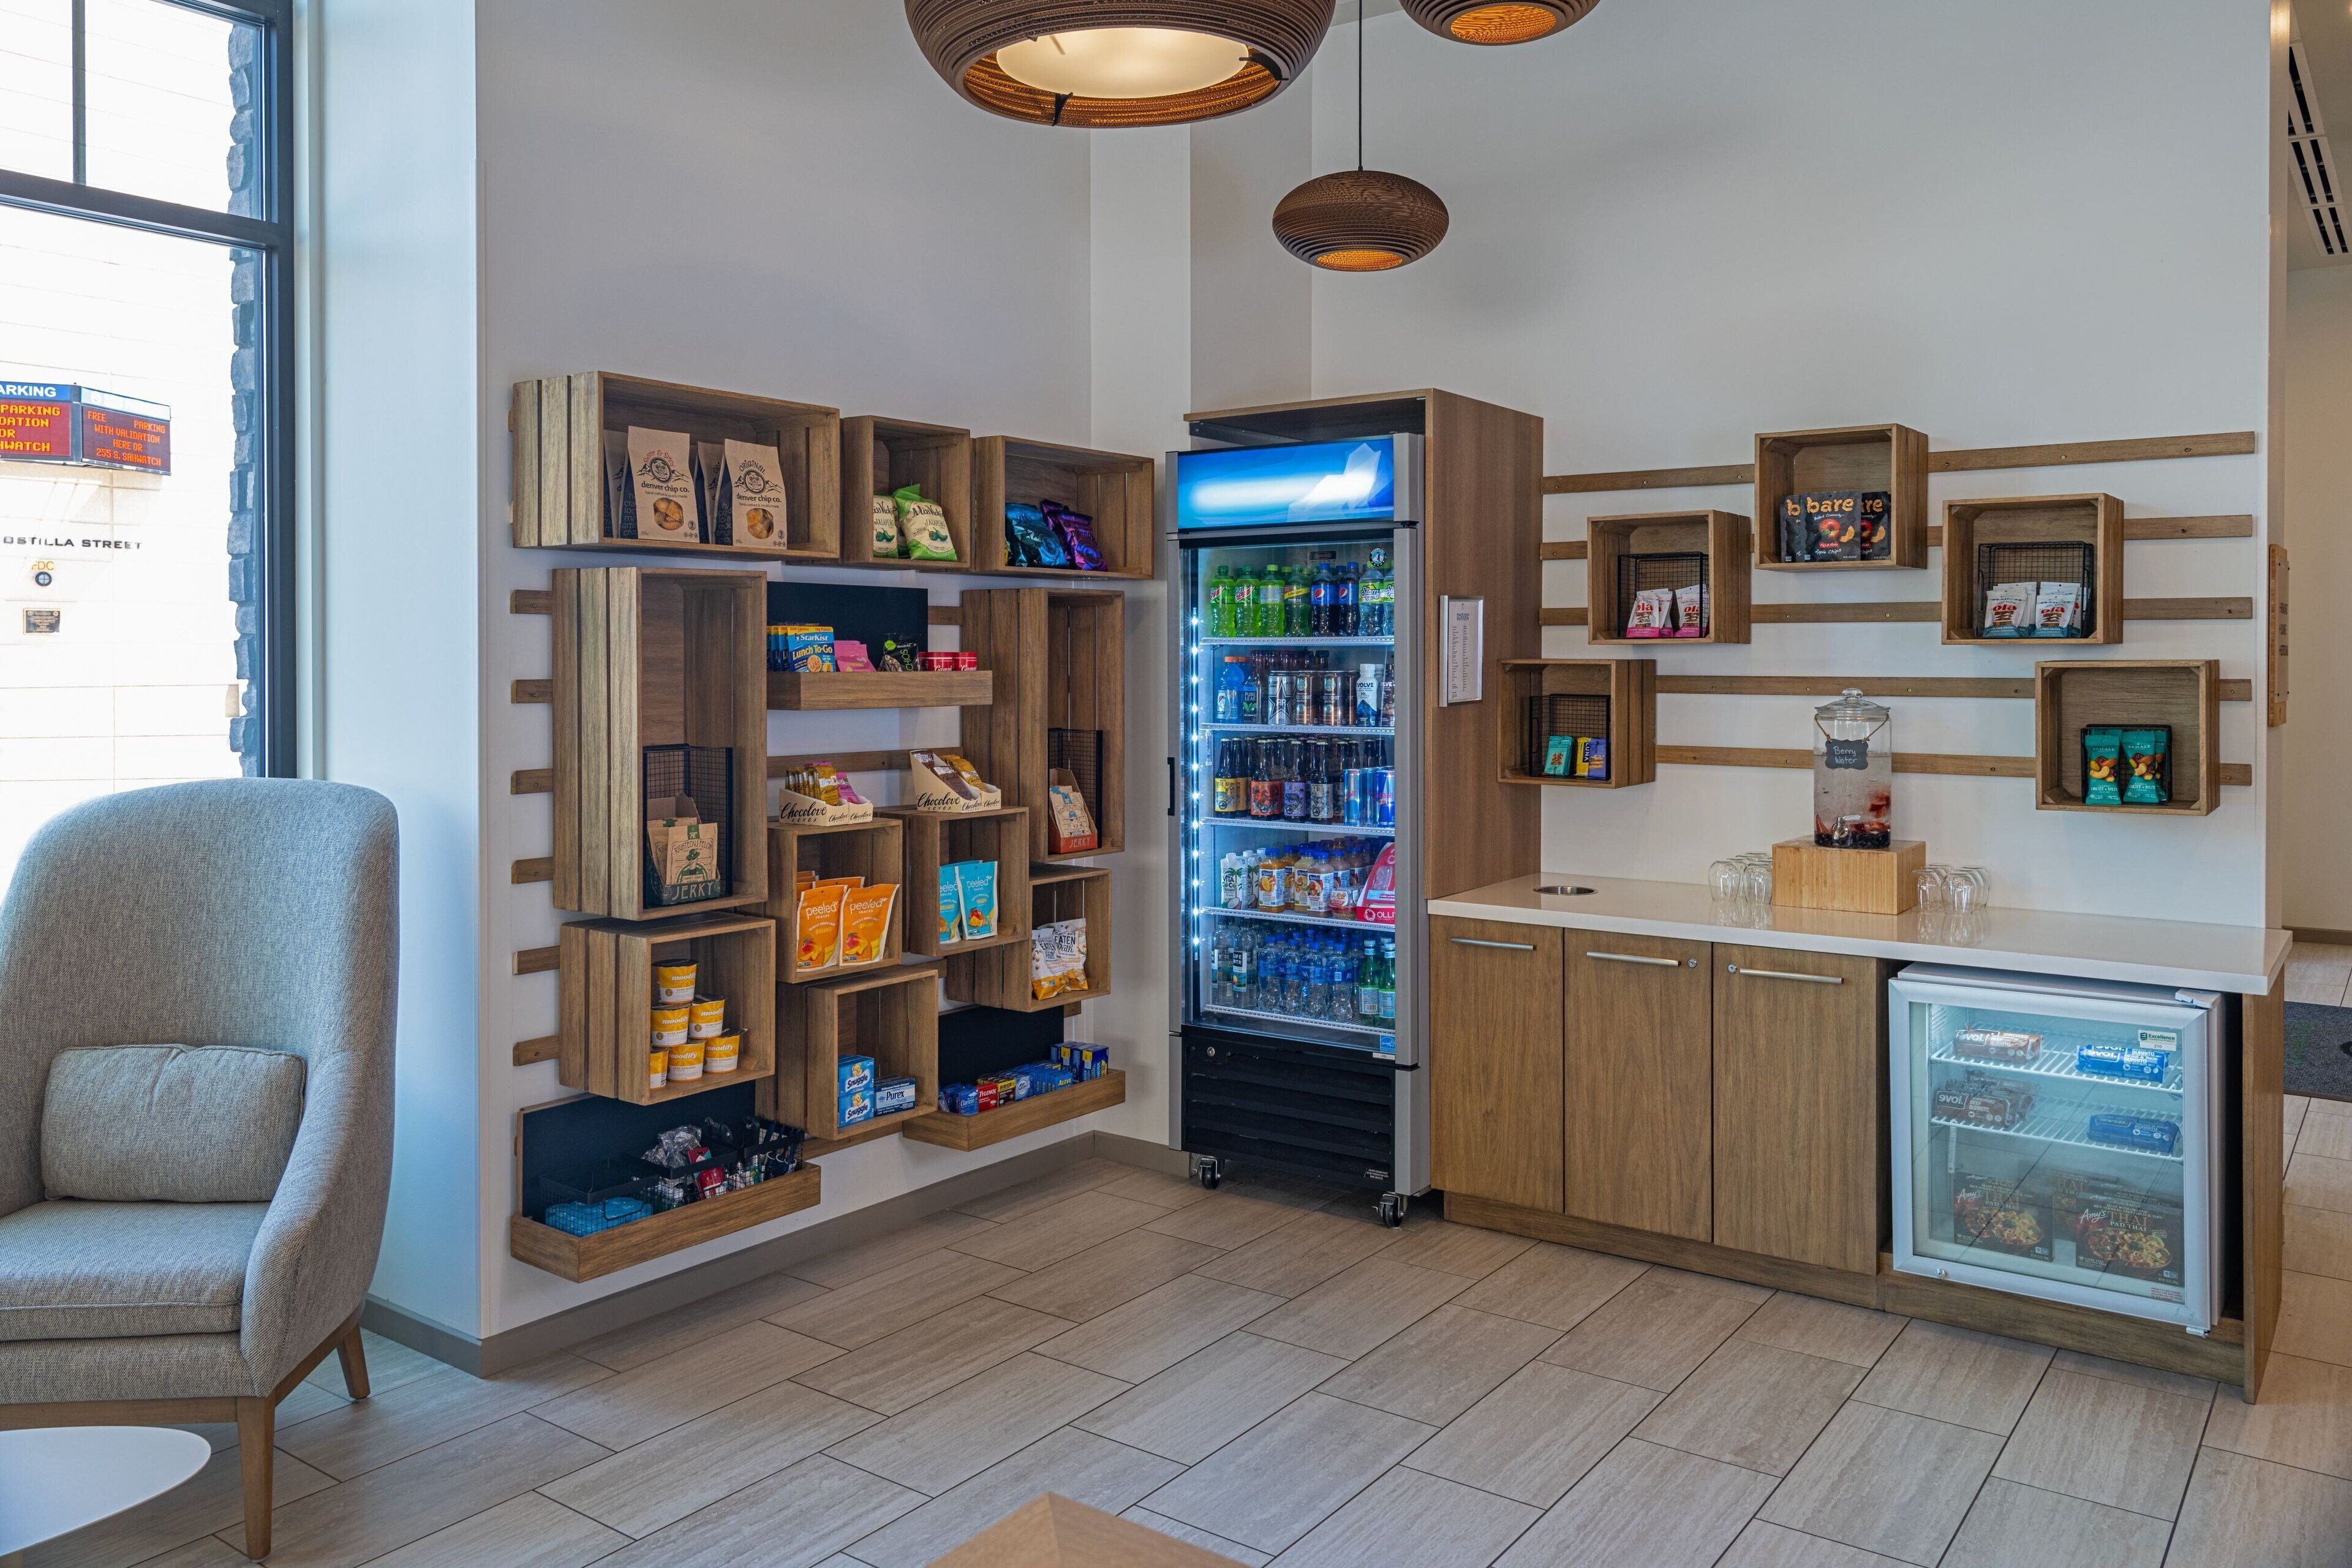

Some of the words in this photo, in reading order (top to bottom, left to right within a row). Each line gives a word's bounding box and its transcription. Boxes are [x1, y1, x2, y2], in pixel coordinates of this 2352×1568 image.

[1, 404, 61, 416] PARKING
[88, 410, 107, 422] FREE
[134, 420, 165, 434] PARKING
[94, 424, 114, 435] WITH
[116, 428, 160, 443] VALIDATION
[113, 439, 131, 450] HERE
[133, 443, 143, 451] OR
[96, 448, 111, 458] 255
[113, 451, 120, 459] S.
[123, 452, 162, 466] SAHWATCH
[641, 481, 663, 491] denver
[736, 493, 757, 502] denver
[1806, 497, 1854, 513] bare
[82, 540, 142, 549] STREET
[1361, 585, 1381, 598] Starry
[1636, 603, 1653, 611] ola
[793, 646, 813, 661] Lunch
[1833, 745, 1856, 756] Berry
[1834, 756, 1857, 764] Water
[916, 792, 960, 807] Chocolove
[983, 798, 1001, 808] Chocolove
[780, 801, 827, 819] Chocolove
[962, 800, 982, 812] Chocolove
[829, 813, 848, 822] Chocolove
[850, 812, 872, 820] Chocolove
[1069, 837, 1091, 848] JERKY
[967, 877, 989, 891] peeled
[672, 881, 714, 900] JERKY
[806, 902, 837, 920] peeled
[850, 899, 882, 914] peeled
[1054, 936, 1076, 944] EATEN
[2087, 1049, 2117, 1058] evol.
[847, 1074, 868, 1089] Snuggle
[886, 1090, 905, 1101] Purex
[979, 1089, 997, 1098] TYLENOL
[1939, 1095, 1964, 1105] evol.
[847, 1103, 868, 1119] Snuggle
[1956, 1189, 1981, 1203] Amy's
[2079, 1208, 2106, 1224] Amy's
[2109, 1212, 2147, 1227] THAI
